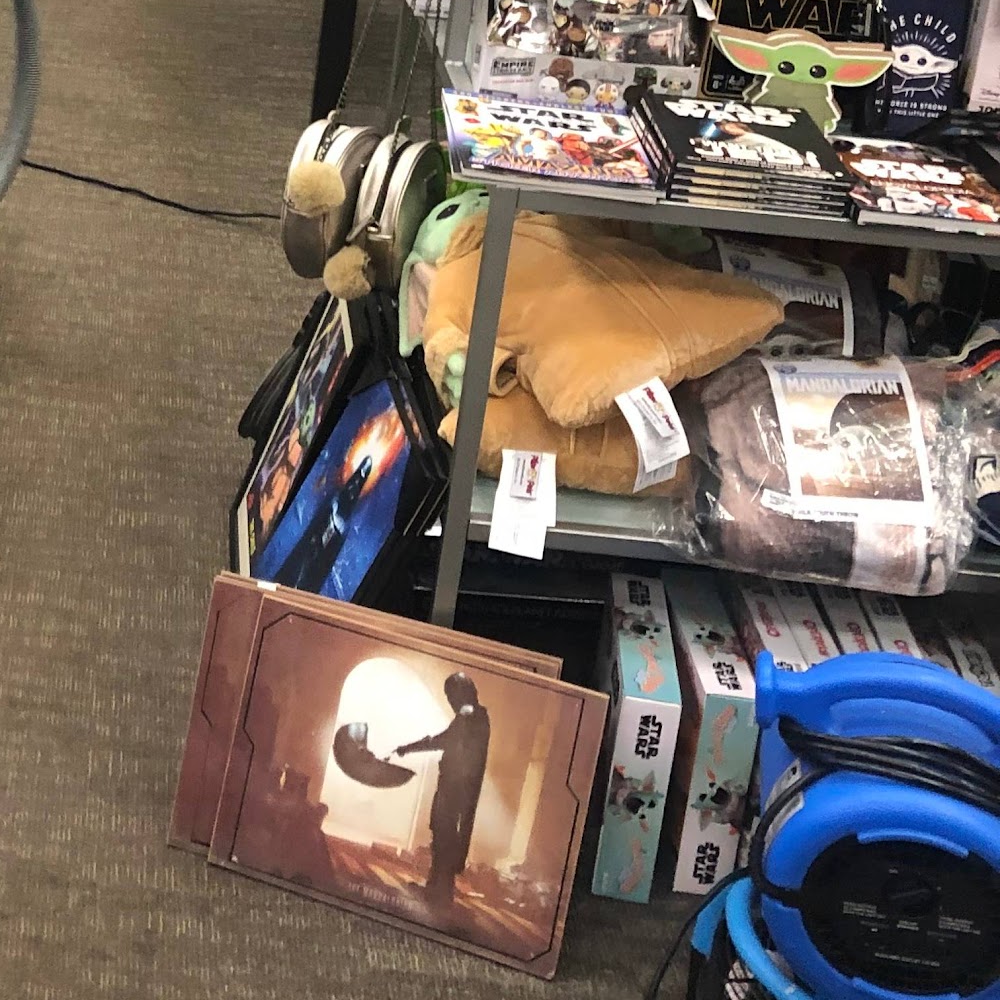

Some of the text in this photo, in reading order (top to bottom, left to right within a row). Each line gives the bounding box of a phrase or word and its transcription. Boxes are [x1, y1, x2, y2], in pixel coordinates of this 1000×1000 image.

[914, 13, 957, 43] CHILD
[487, 105, 594, 123] STAR
[490, 113, 597, 132] WARS
[786, 374, 900, 395] MANDALORIAN
[634, 714, 652, 760] WARS
[645, 714, 663, 759] STAR
[692, 843, 711, 884] STAR
[702, 842, 720, 885] WARS
